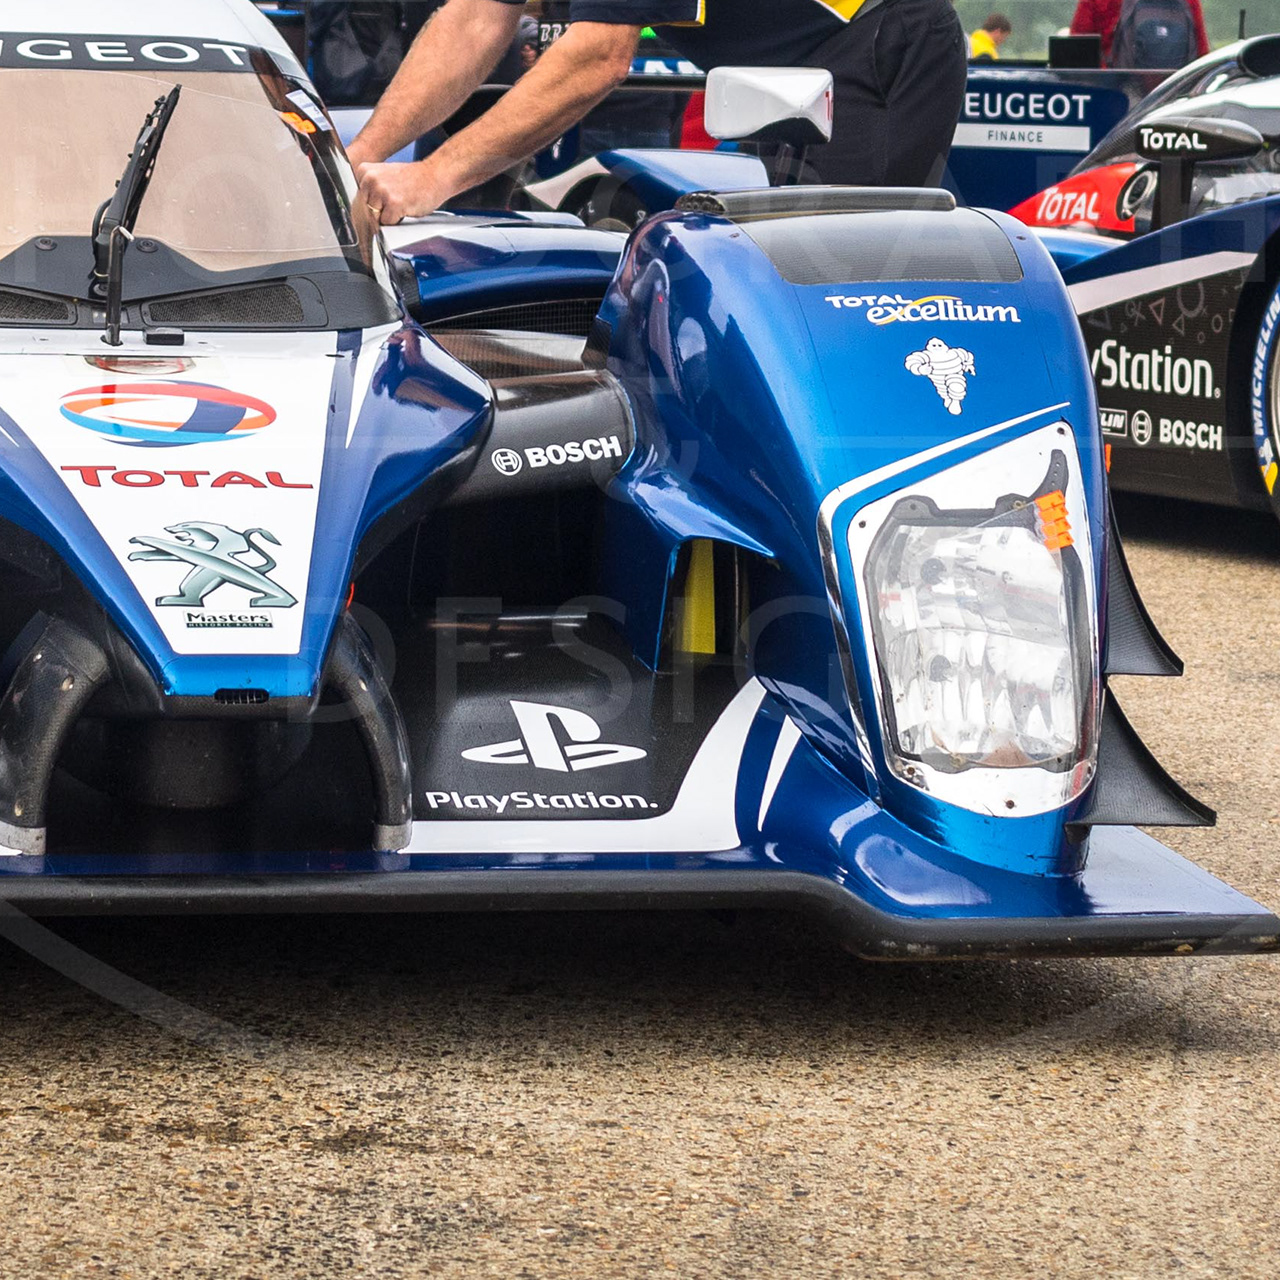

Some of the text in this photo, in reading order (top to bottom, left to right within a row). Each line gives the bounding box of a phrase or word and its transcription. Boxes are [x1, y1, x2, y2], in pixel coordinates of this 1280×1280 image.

[964, 93, 1091, 120] EUGEOT
[987, 129, 1043, 143] FINANCE
[1140, 128, 1207, 150] TOTAL
[1036, 187, 1100, 220] TOTAL
[824, 295, 913, 308] TOTAL
[866, 298, 1021, 324] excellium
[1091, 339, 1213, 398] Station
[1159, 418, 1223, 451] BOSCH
[524, 435, 622, 468] BOSCH
[61, 466, 314, 489] TOTAL
[187, 612, 269, 623] Masters
